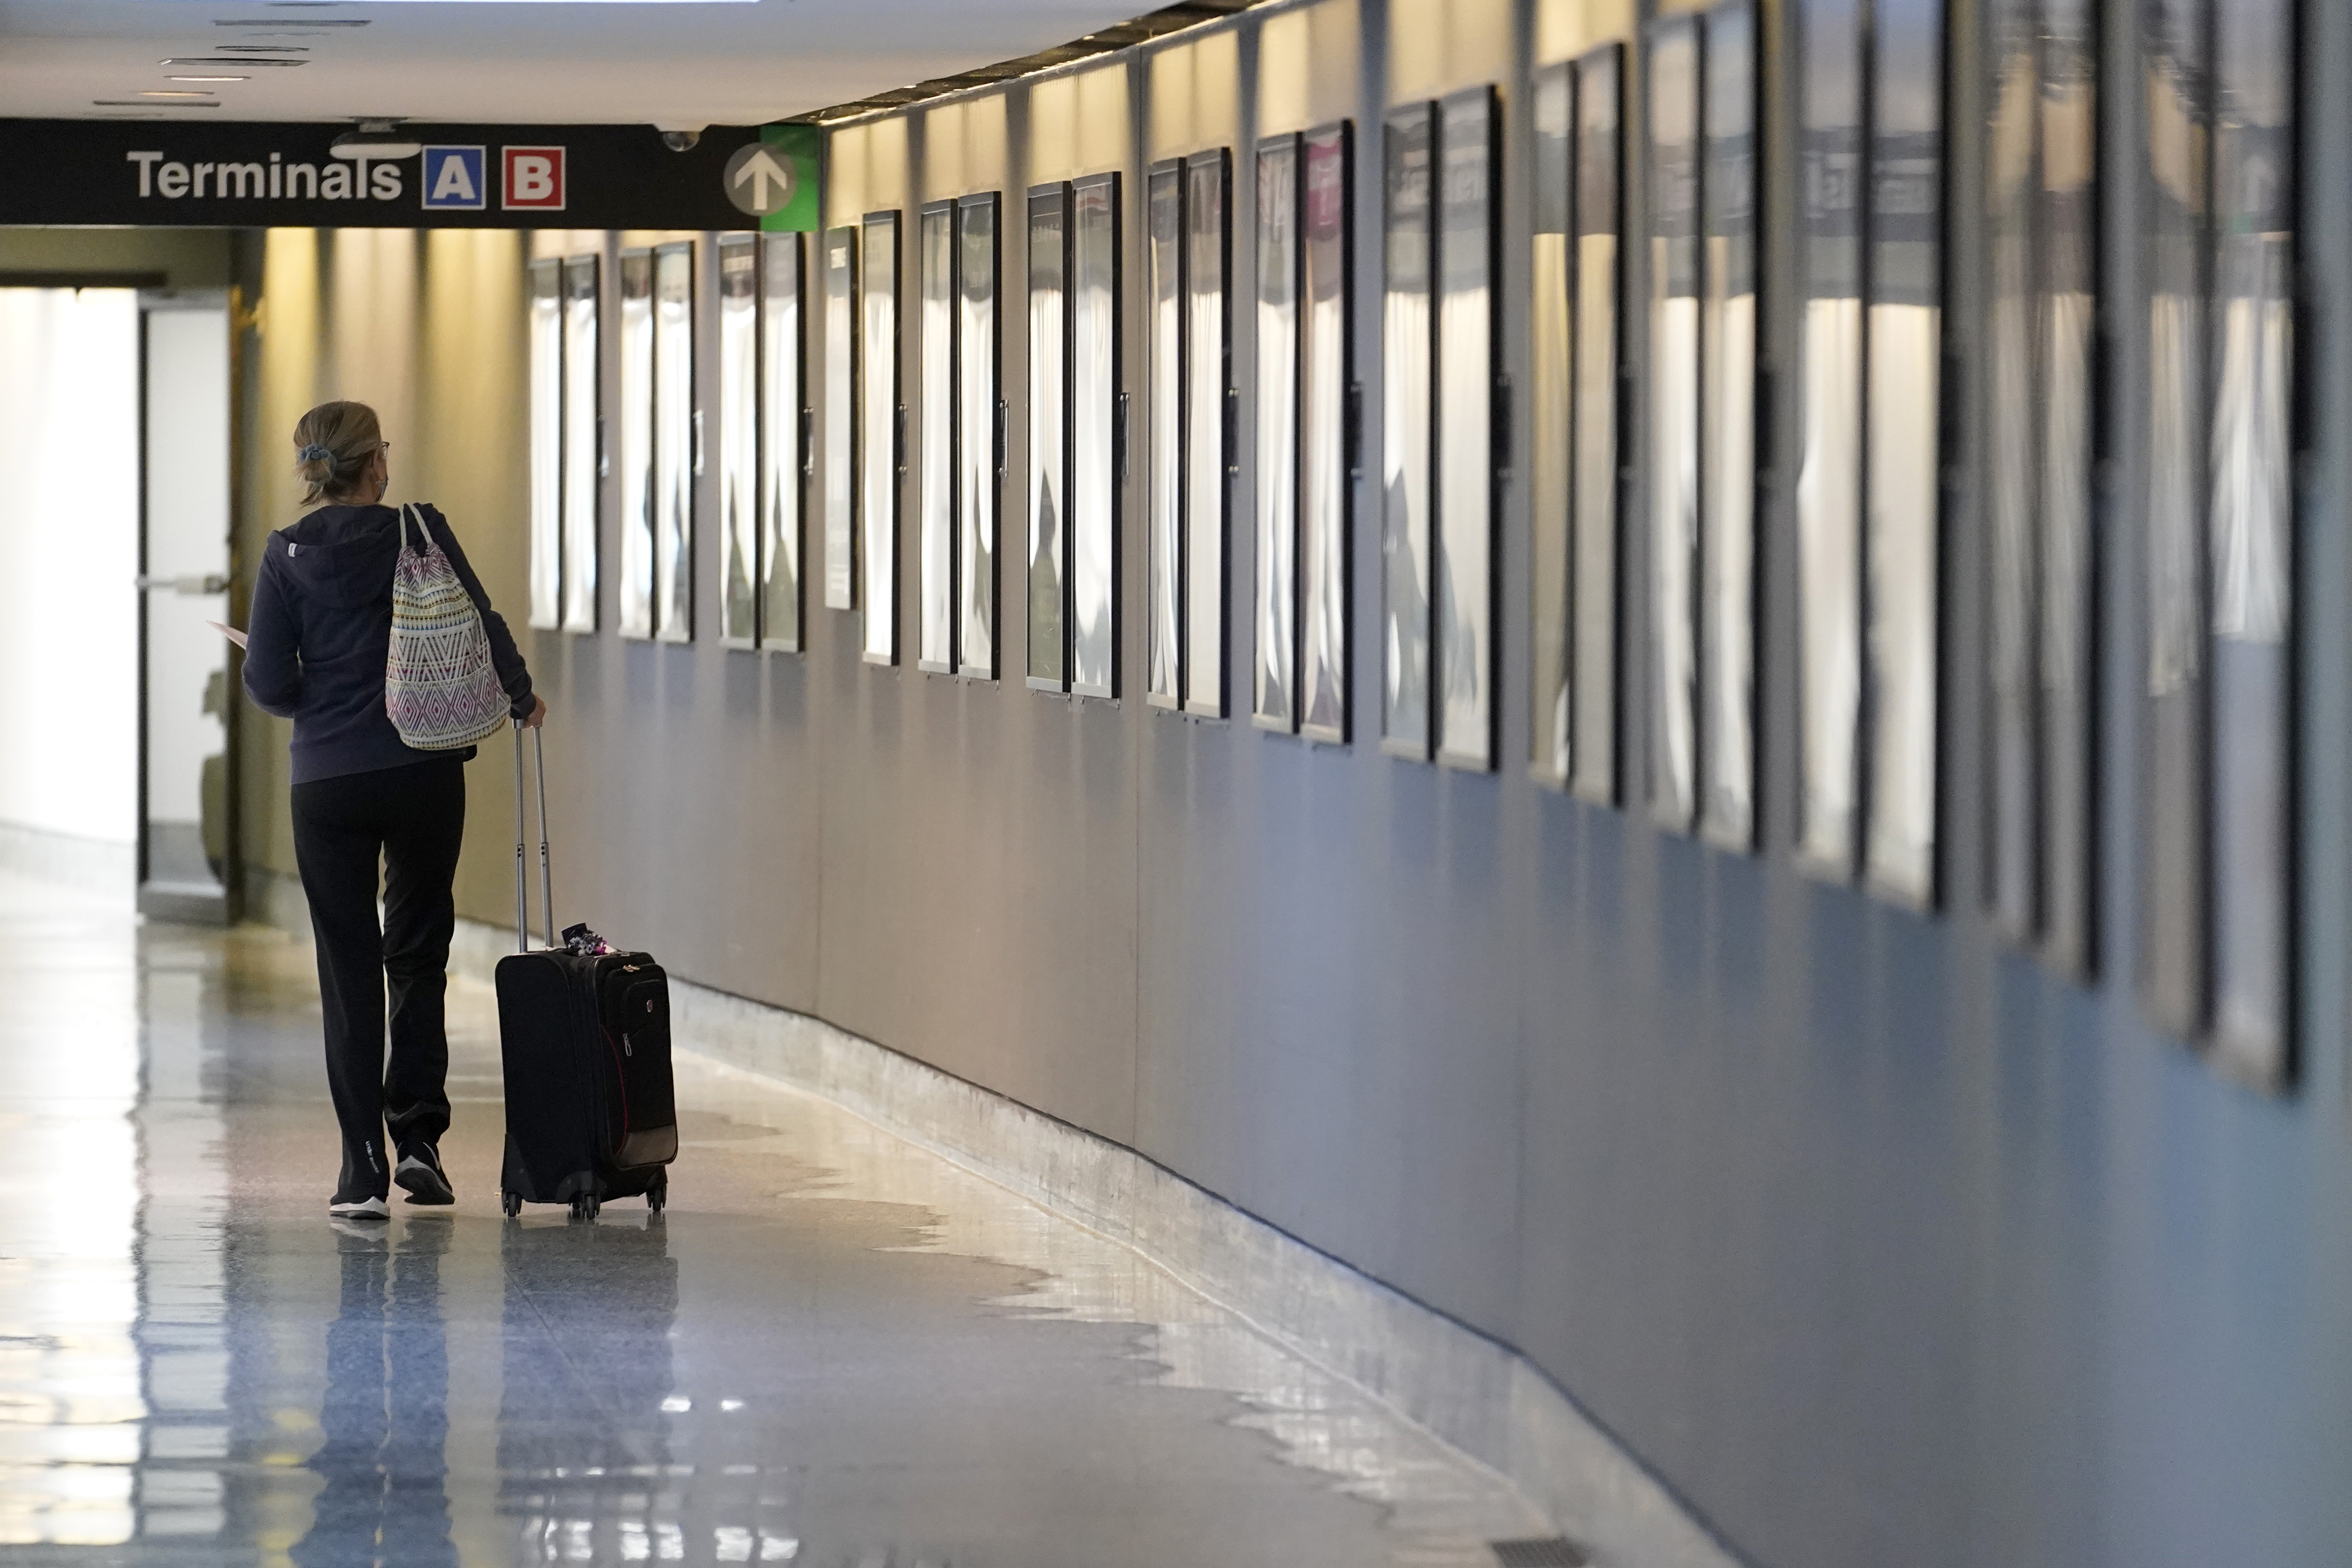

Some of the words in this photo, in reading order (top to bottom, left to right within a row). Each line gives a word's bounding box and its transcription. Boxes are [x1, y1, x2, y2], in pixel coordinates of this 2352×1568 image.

[127, 151, 402, 199] Terminals
[432, 155, 476, 199] A
[514, 157, 554, 199] B
